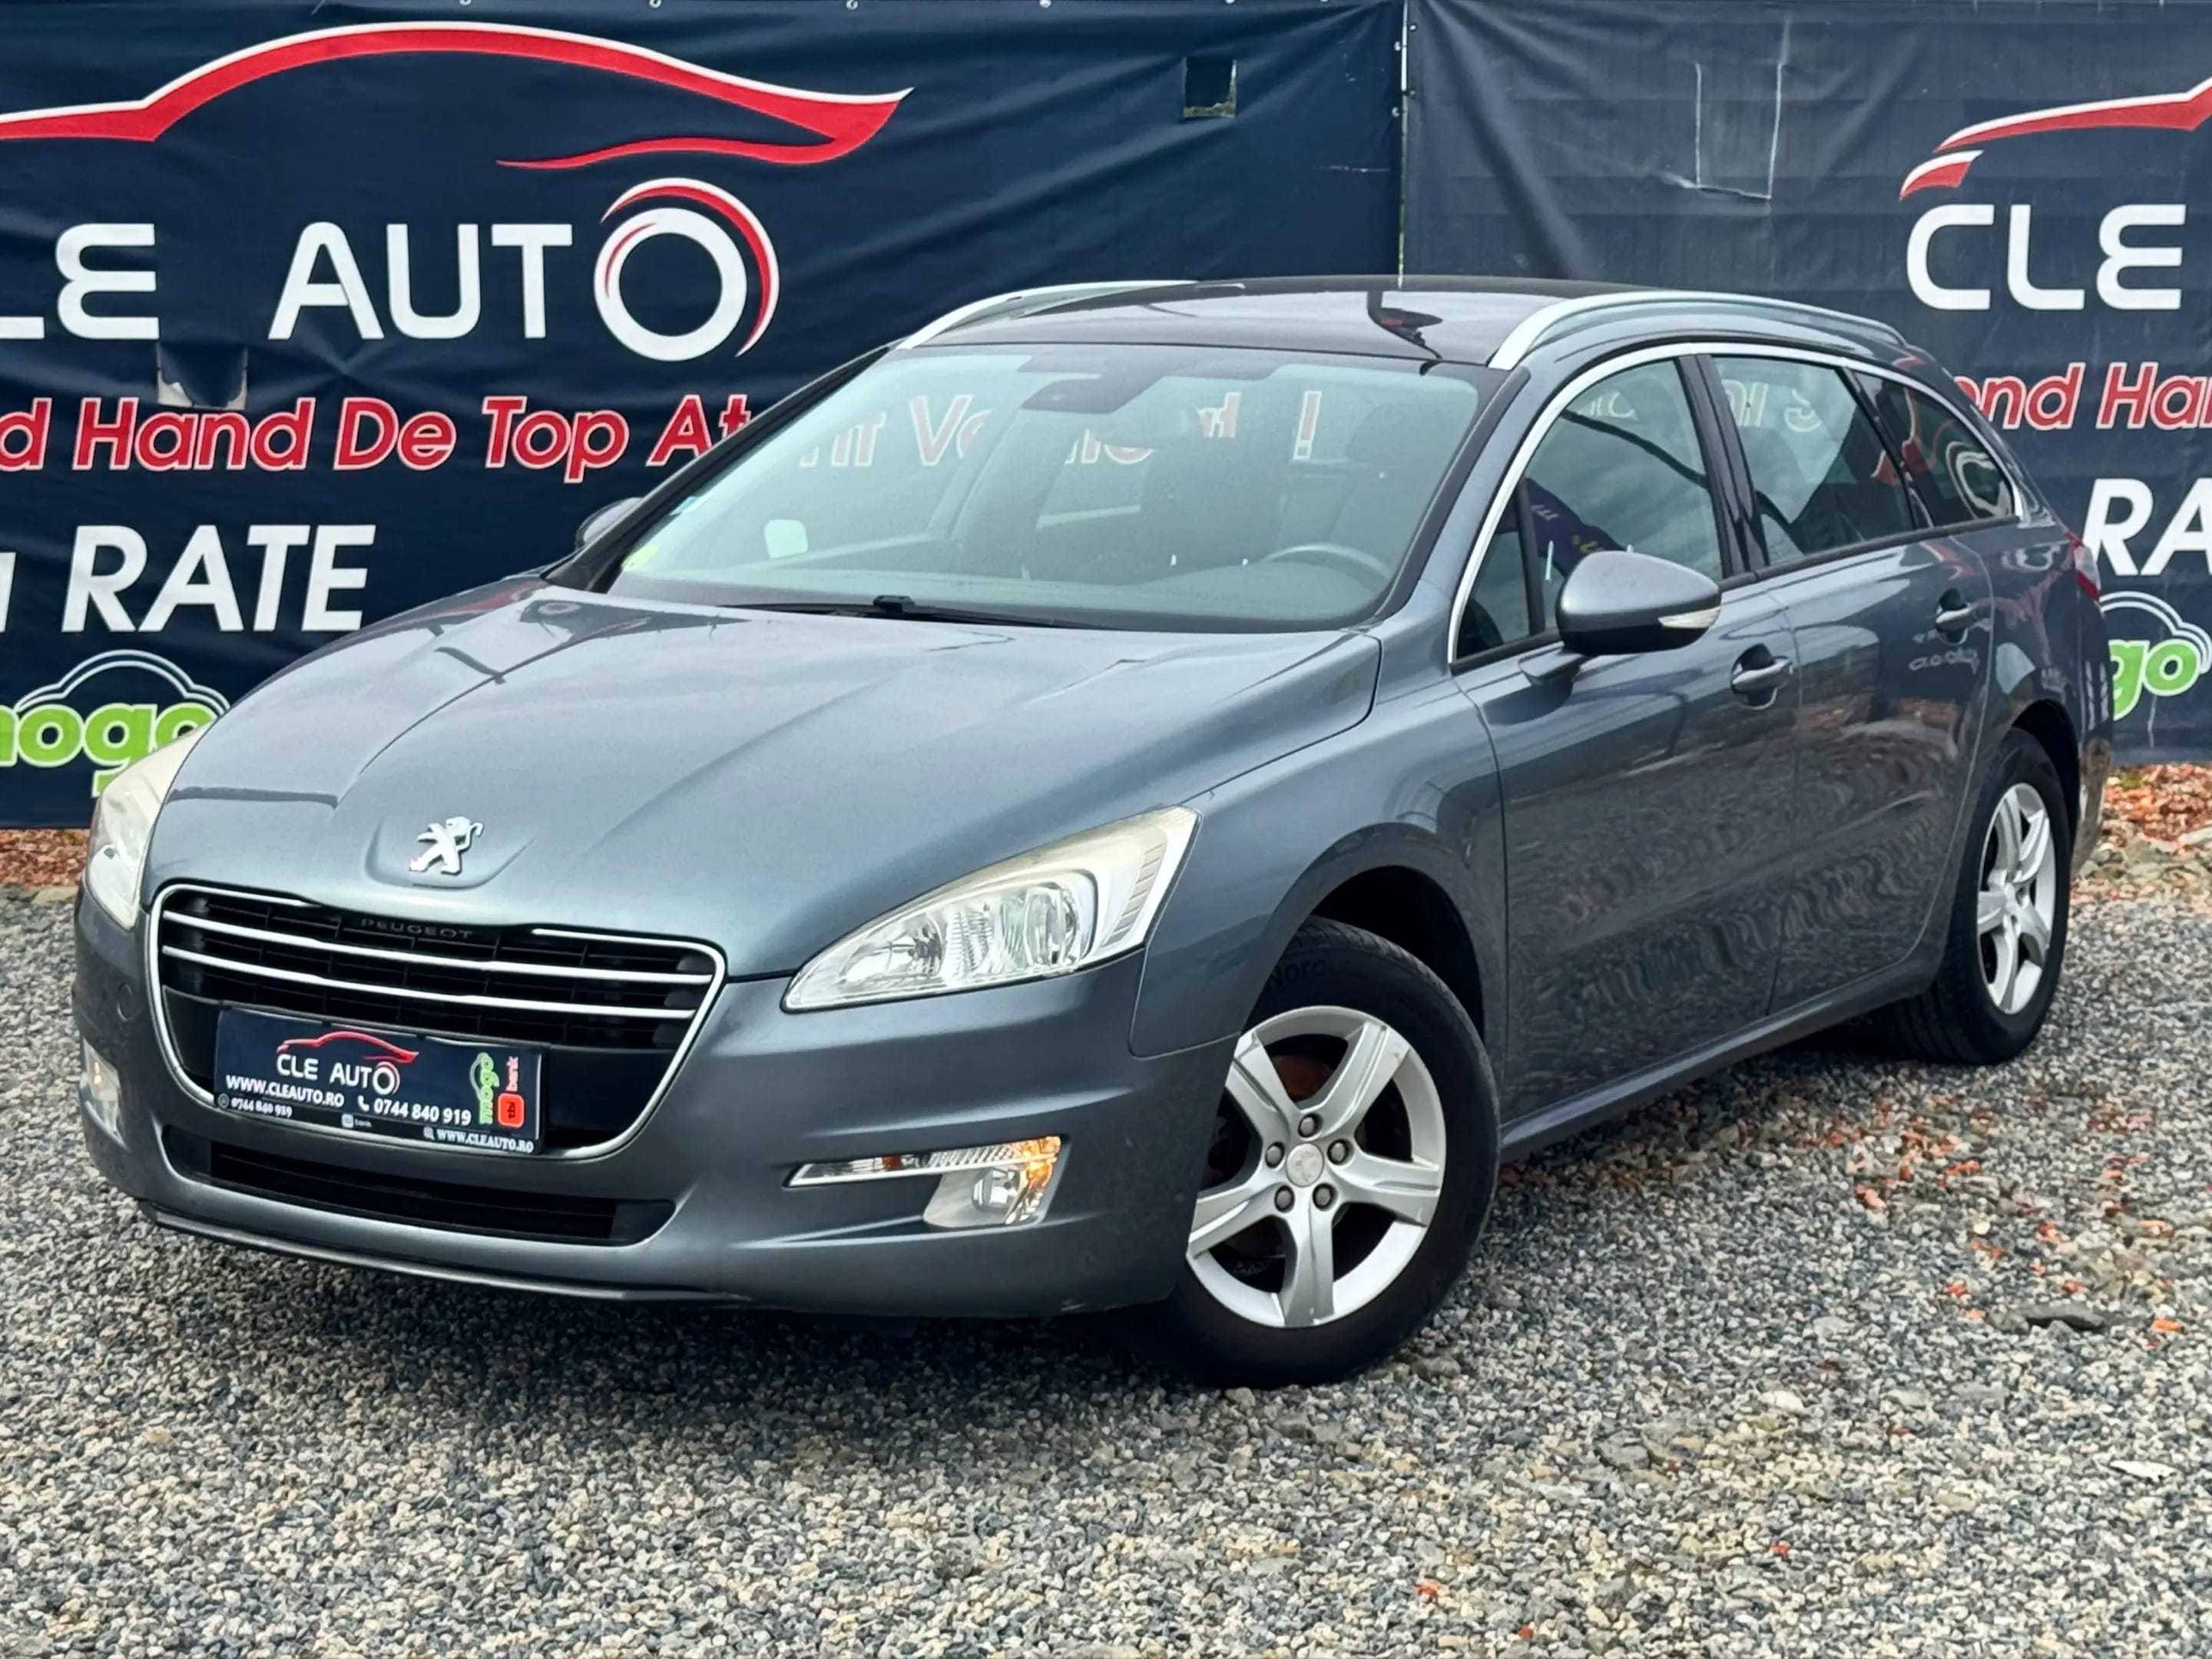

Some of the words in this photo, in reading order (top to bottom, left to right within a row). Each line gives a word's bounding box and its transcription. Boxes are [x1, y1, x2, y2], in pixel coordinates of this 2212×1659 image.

[268, 207, 748, 362] AUTO
[1906, 204, 2187, 310] CLE
[2096, 362, 2212, 430] Ha
[72, 396, 316, 472] Hand
[333, 396, 456, 471] De
[482, 396, 629, 484] Top
[61, 525, 376, 633] RATE
[361, 918, 474, 939] PEUGEOT
[226, 1075, 346, 1108] WWW.CLEAUTO.RO
[276, 1054, 320, 1081] CLE
[329, 1062, 396, 1096] AUTO
[479, 1054, 500, 1125] mogo
[373, 1098, 409, 1118] 0744
[411, 1103, 440, 1123] 840
[442, 1107, 472, 1127] 919
[436, 1128, 535, 1154] WWW.CLEAUTO.RO
